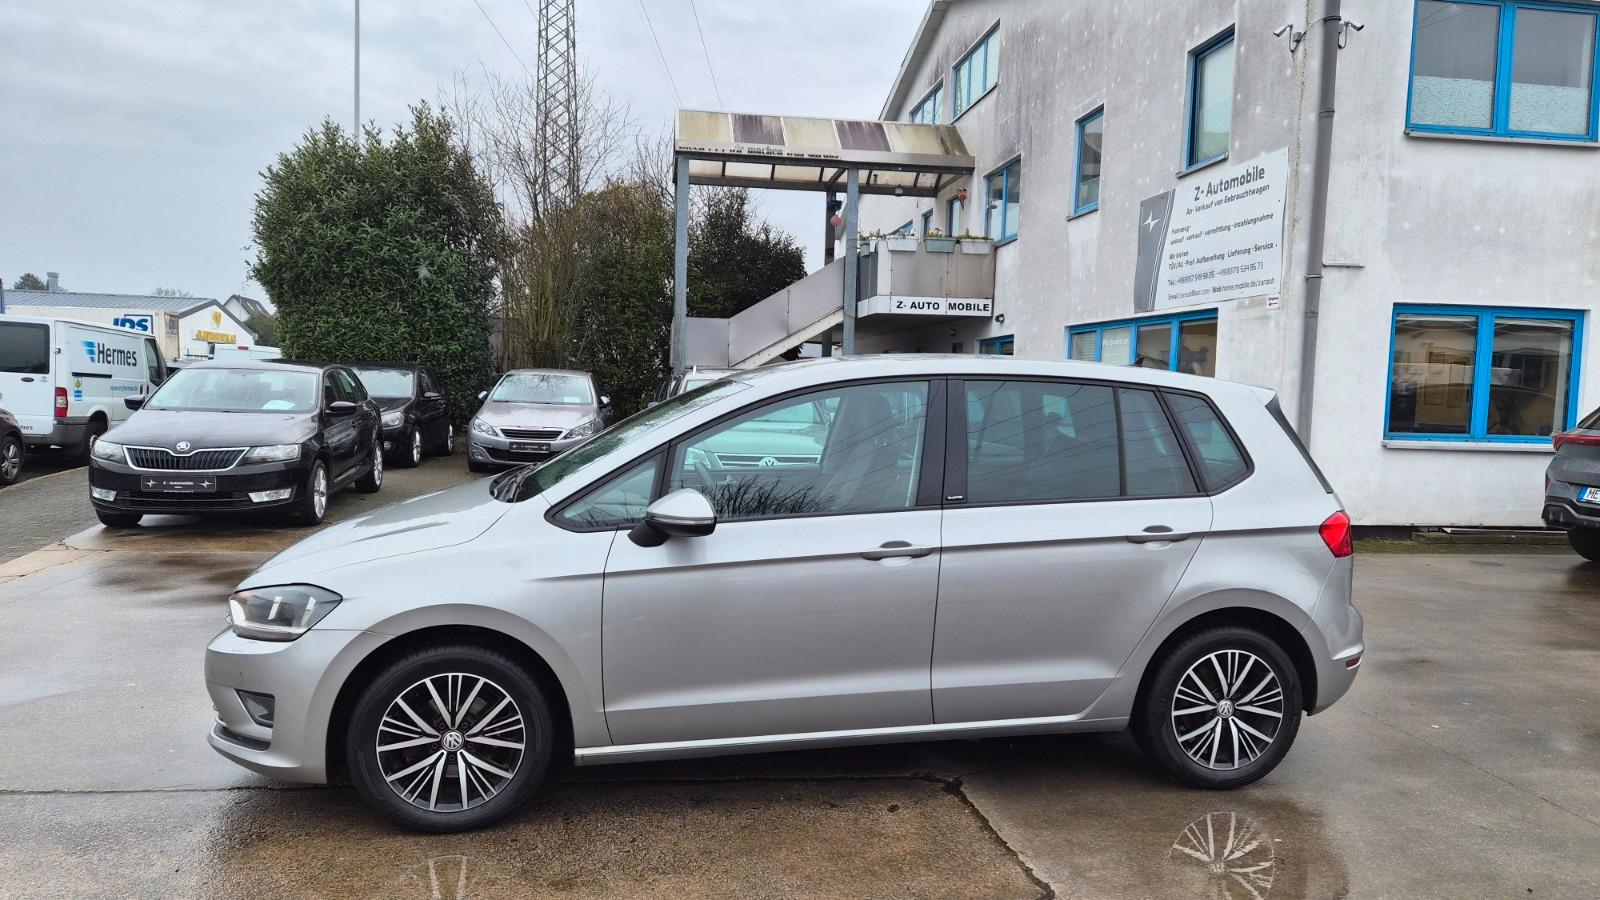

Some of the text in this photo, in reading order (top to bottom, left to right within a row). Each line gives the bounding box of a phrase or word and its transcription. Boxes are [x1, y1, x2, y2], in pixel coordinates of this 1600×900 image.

[1206, 165, 1265, 198] Automobile
[1195, 200, 1213, 213] Verkauf
[1224, 184, 1270, 204] Gebrauchtwagen
[1227, 247, 1251, 257] Lieferung
[1254, 242, 1274, 252] Service
[910, 301, 940, 310] AUTO
[948, 302, 990, 312] MOBILE
[97, 342, 137, 367] Hermes
